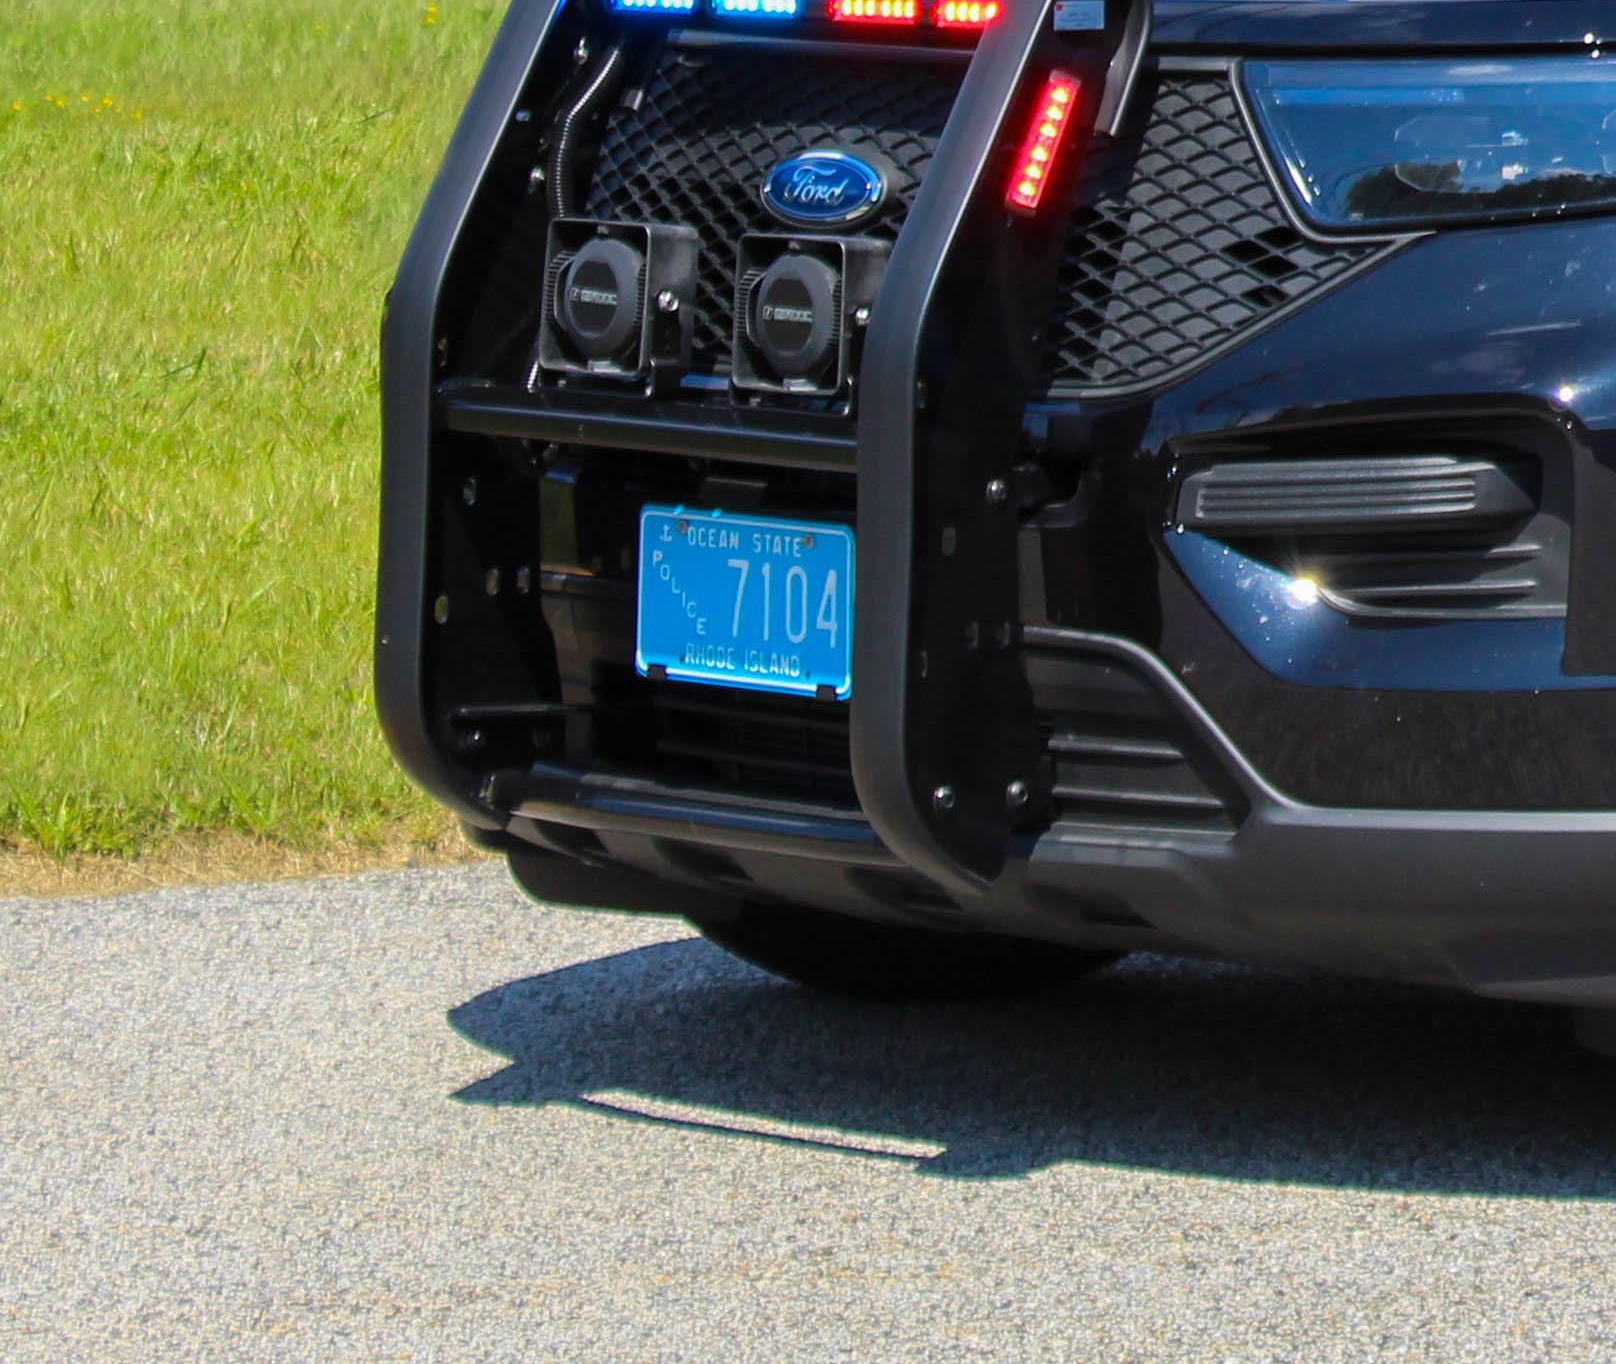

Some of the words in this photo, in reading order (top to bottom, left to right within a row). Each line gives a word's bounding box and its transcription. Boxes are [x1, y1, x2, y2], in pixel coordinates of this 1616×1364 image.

[784, 166, 850, 204] Ford
[687, 526, 739, 550] OCEAN
[752, 532, 803, 558] STATE
[652, 550, 706, 635] POLICE
[728, 558, 838, 649] 7104
[685, 642, 736, 671] RHODE
[744, 650, 801, 678] ISLAND
